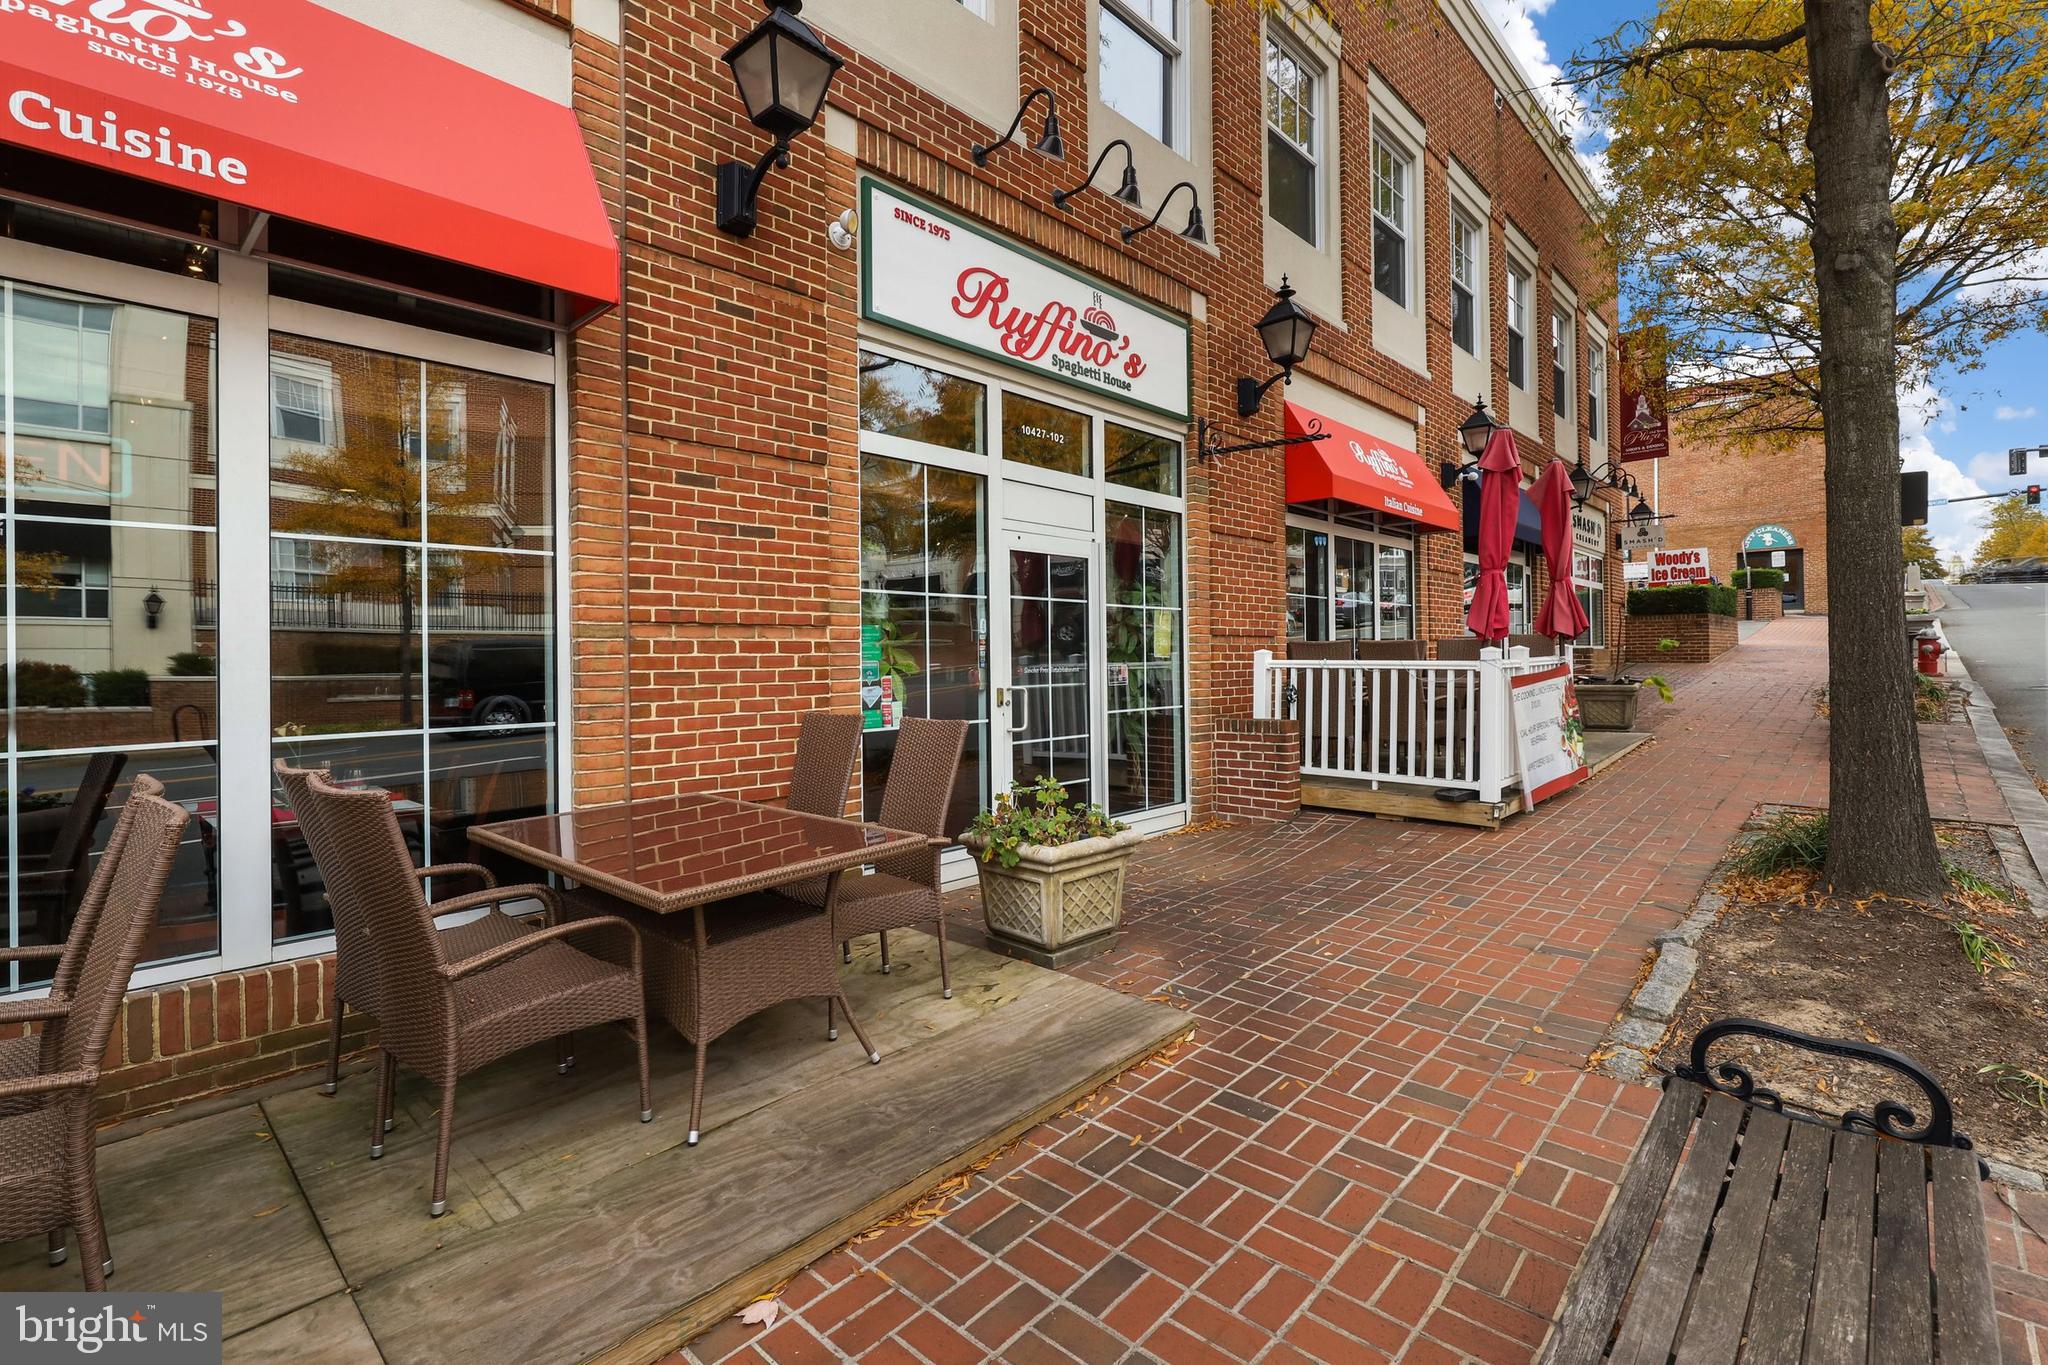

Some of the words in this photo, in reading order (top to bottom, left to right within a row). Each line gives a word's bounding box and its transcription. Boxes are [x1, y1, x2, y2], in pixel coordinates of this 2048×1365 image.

[87, 40, 177, 78] SINCE
[184, 71, 243, 99] 1975
[188, 54, 298, 104] House
[8, 90, 248, 185] Cuisine
[894, 207, 926, 231] SINCE
[927, 222, 951, 241] 1975
[951, 267, 1147, 379] Ruffino's
[1051, 354, 1102, 382] Spaghetti
[1102, 370, 1132, 392] House
[1021, 424, 1065, 444] 10427-102
[1384, 495, 1404, 511] Italian
[1623, 536, 1664, 545] SMASH'D
[1651, 568, 1669, 581] Ice
[1654, 550, 1701, 567] Woody's
